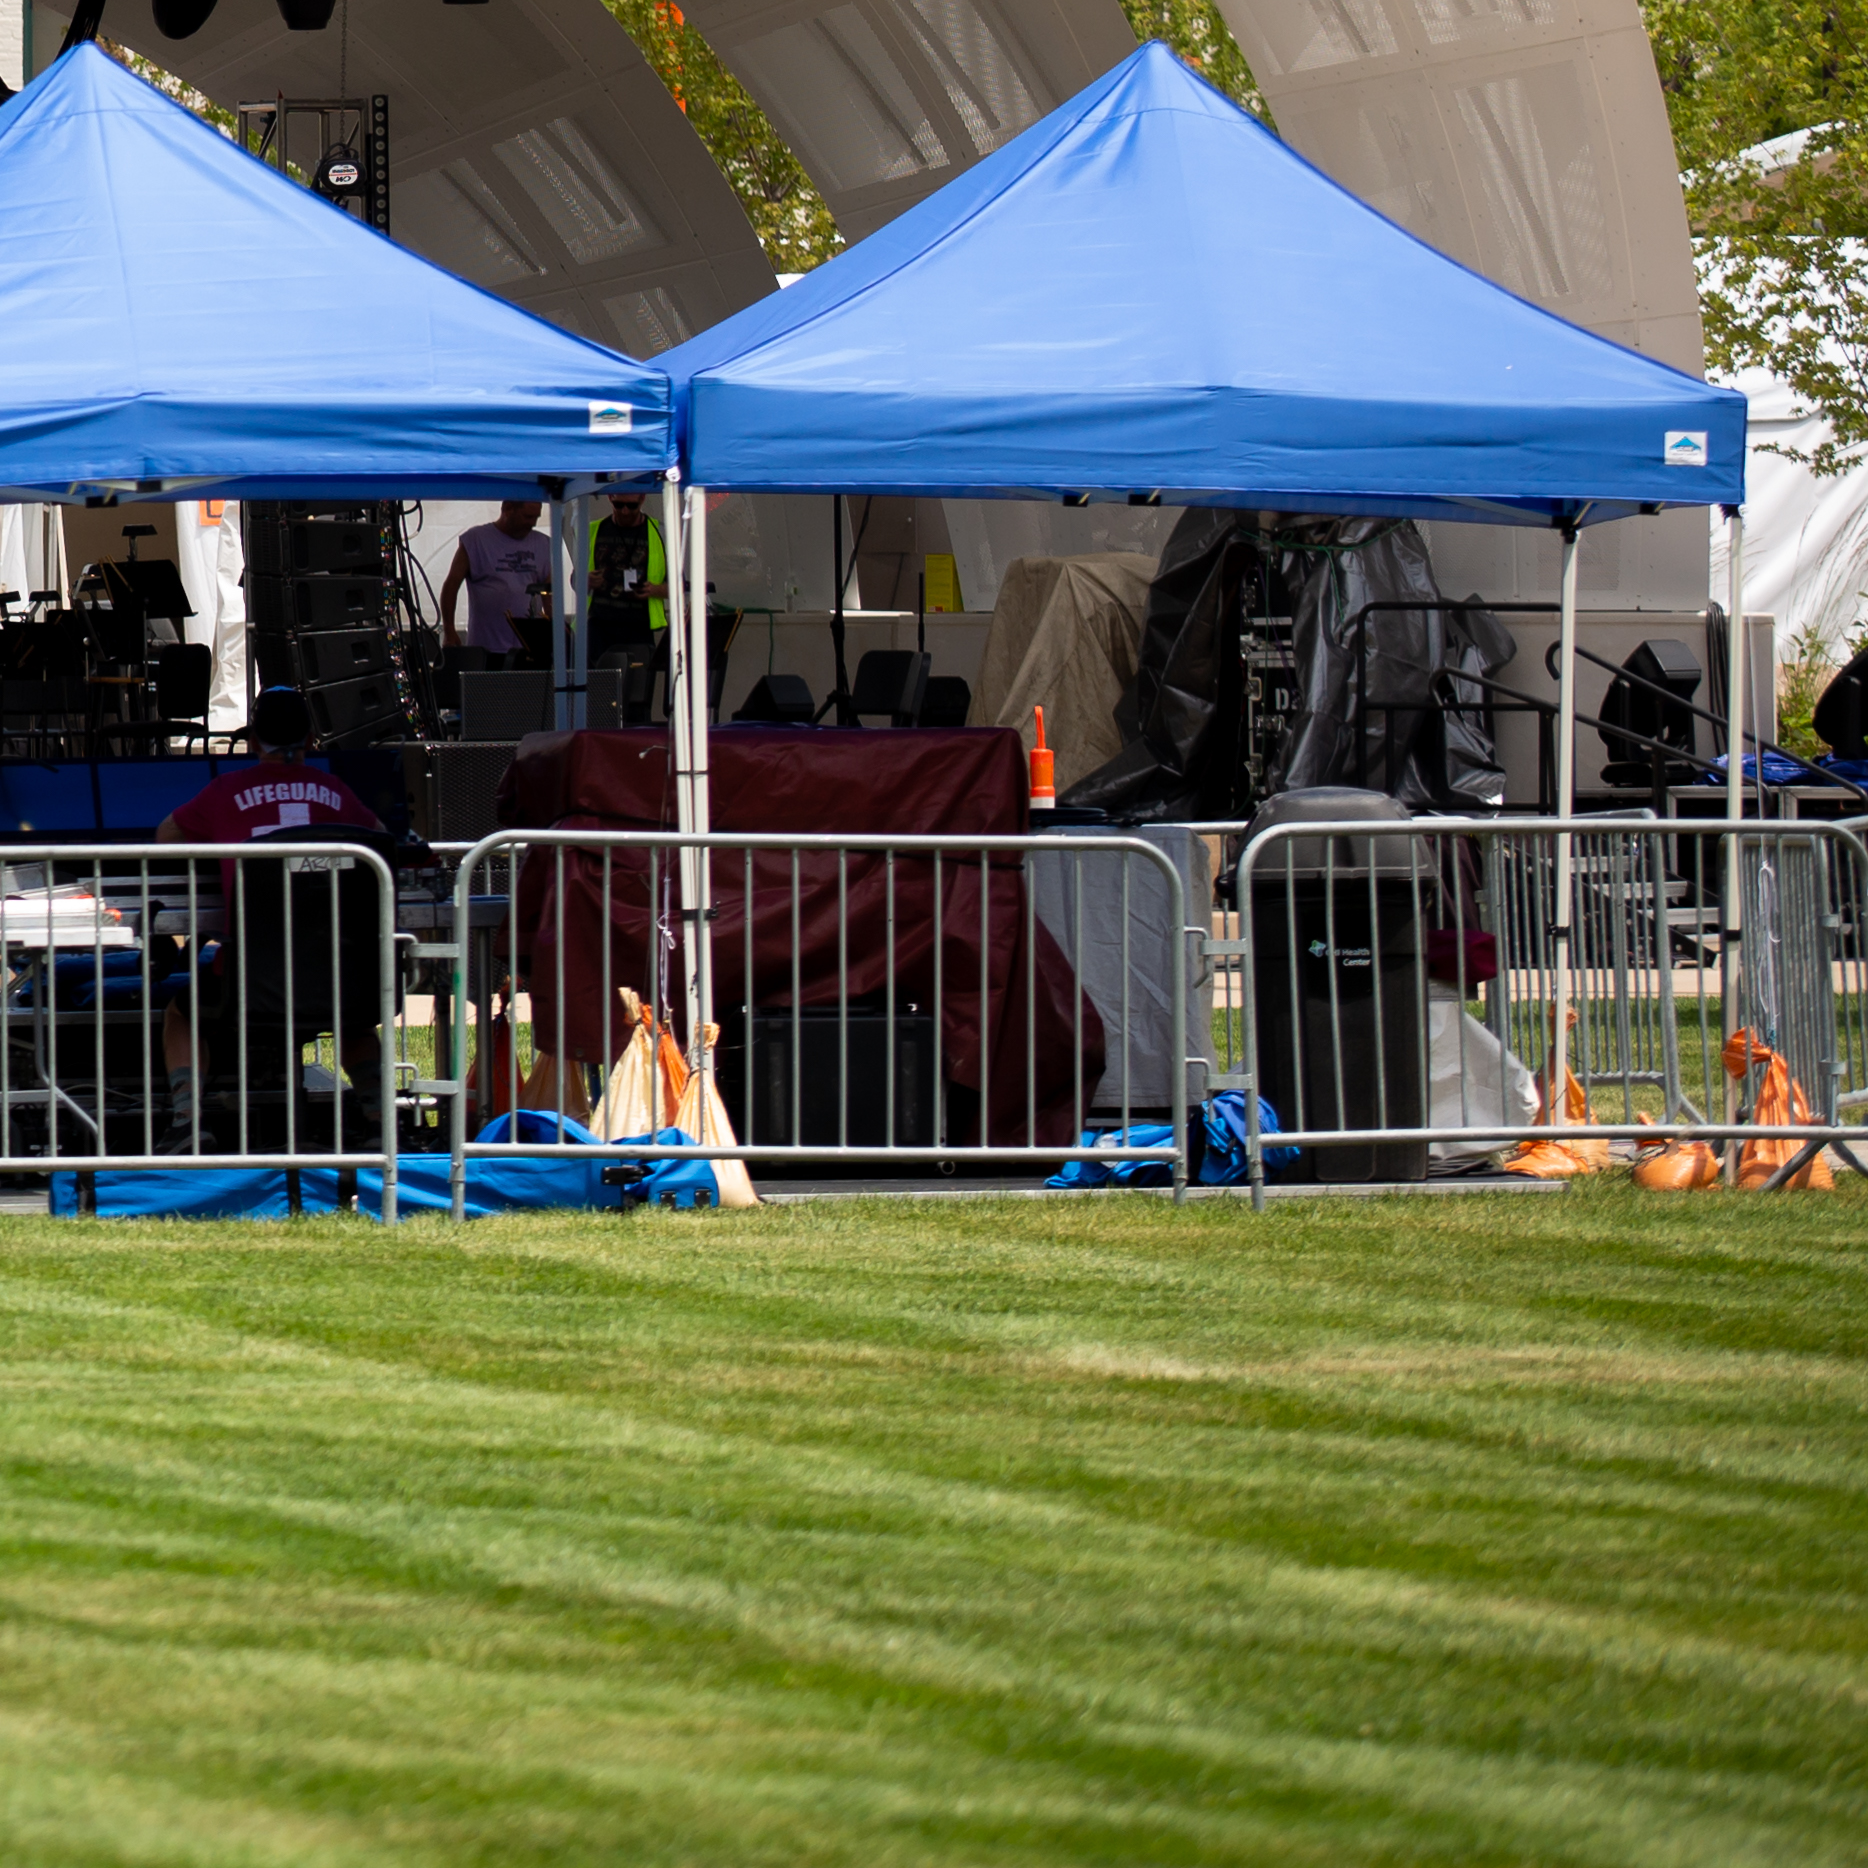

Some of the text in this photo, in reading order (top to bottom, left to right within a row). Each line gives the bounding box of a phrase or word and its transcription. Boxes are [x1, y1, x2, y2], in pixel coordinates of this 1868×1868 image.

[233, 782, 342, 812] LIFEGUARD
[1342, 947, 1371, 956] Health
[1342, 958, 1371, 967] Center
